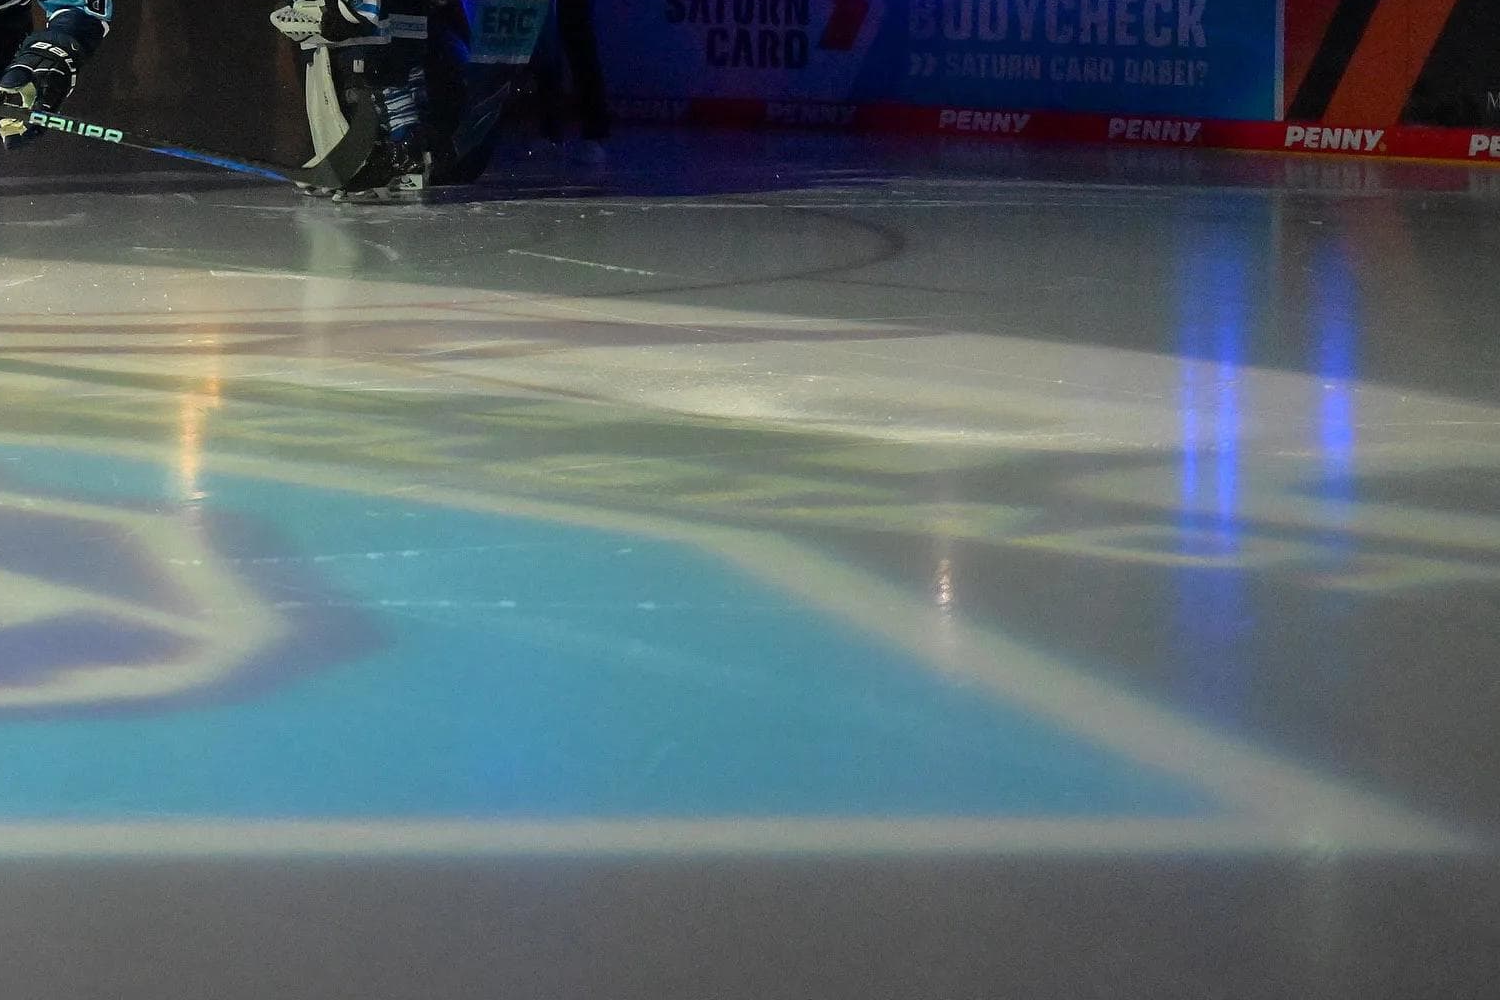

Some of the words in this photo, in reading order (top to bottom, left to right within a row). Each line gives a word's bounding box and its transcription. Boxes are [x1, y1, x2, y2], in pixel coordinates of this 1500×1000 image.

[706, 27, 810, 68] CARD
[943, 55, 1042, 81] SATURN
[1049, 58, 1117, 84] CARD
[1122, 58, 1209, 88] DABEI?
[28, 110, 125, 145] BAUER
[938, 109, 1030, 135] PENNY
[1107, 117, 1203, 143] PENNY
[1284, 126, 1388, 152] PENNY.
